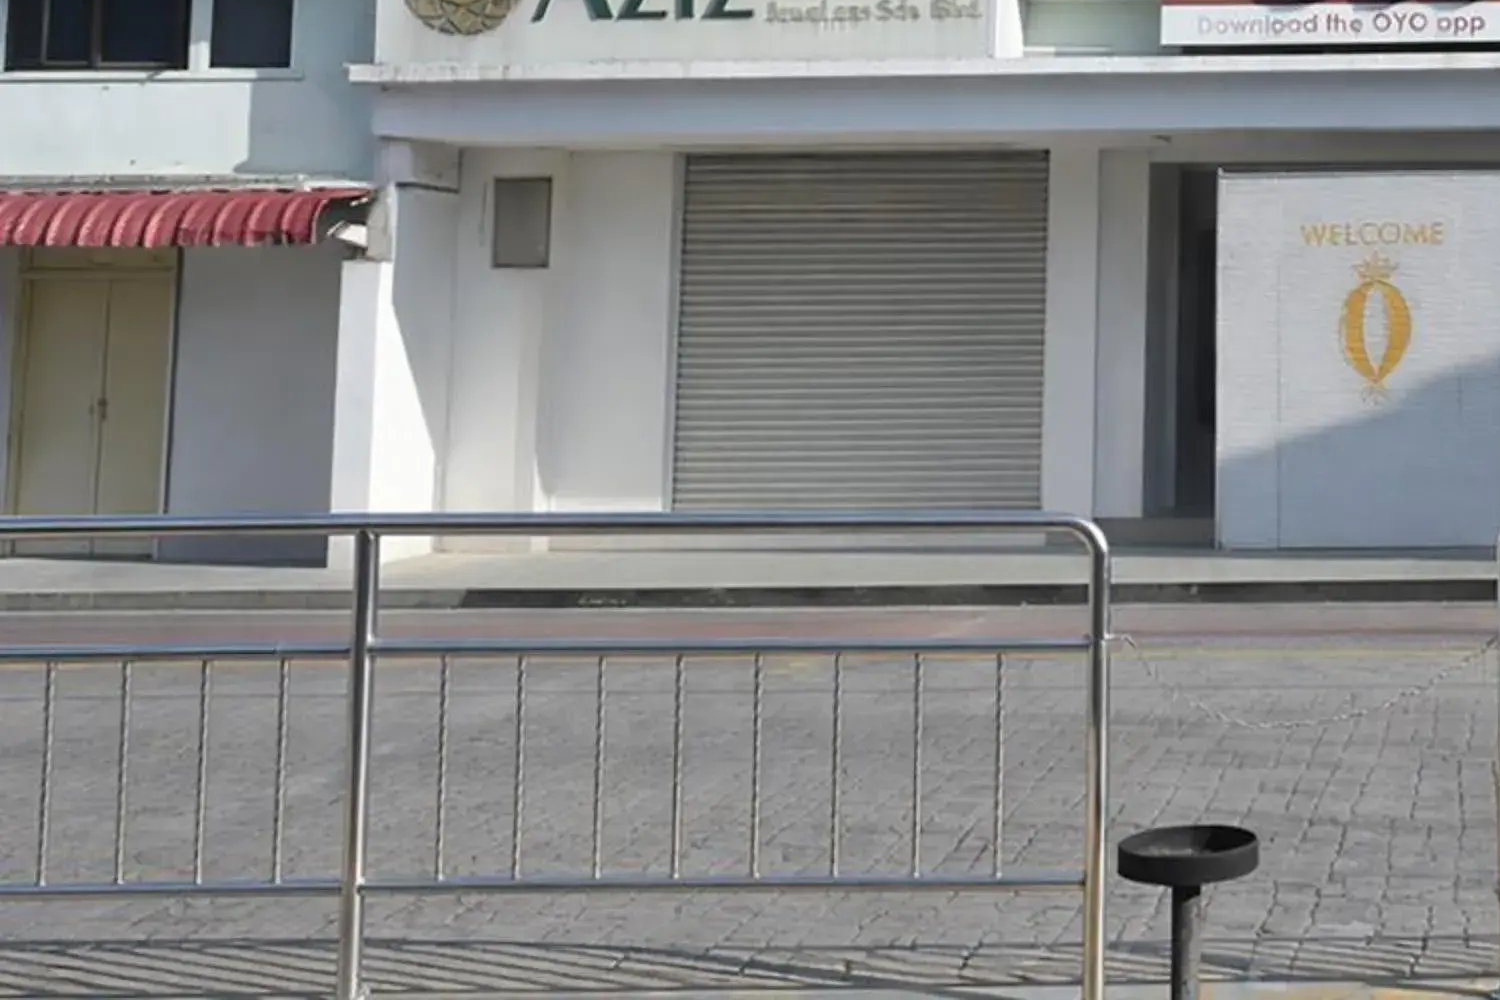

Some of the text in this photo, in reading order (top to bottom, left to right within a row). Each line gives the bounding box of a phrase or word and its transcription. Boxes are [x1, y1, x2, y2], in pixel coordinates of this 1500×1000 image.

[1199, 12, 1485, 37] Download the OYO app
[1301, 221, 1444, 246] WELCOME
